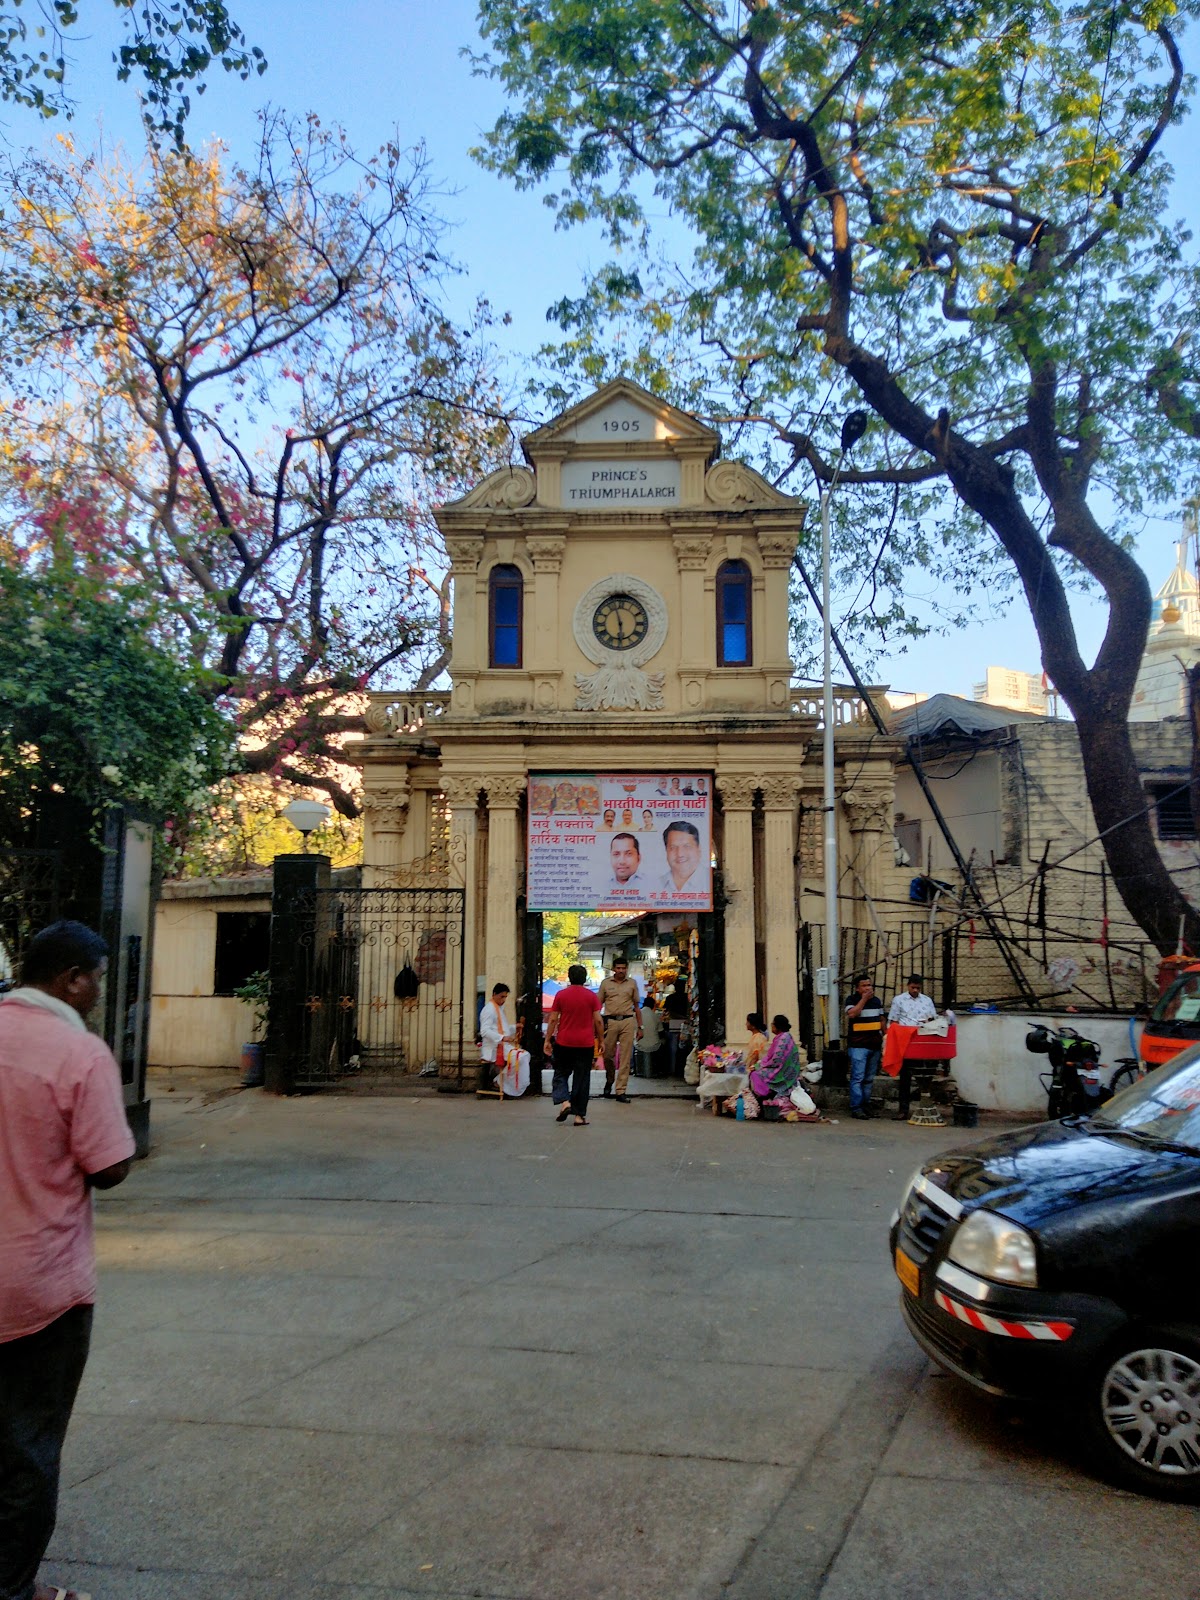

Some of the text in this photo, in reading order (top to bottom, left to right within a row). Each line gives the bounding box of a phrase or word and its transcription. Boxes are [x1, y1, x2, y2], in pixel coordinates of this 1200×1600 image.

[603, 421, 640, 432] 1905
[603, 796, 707, 809] भारतीय जनता पार्टी
[532, 815, 594, 829] सर्व भक्तांचे
[530, 829, 596, 845] हार्दिक स्वागत
